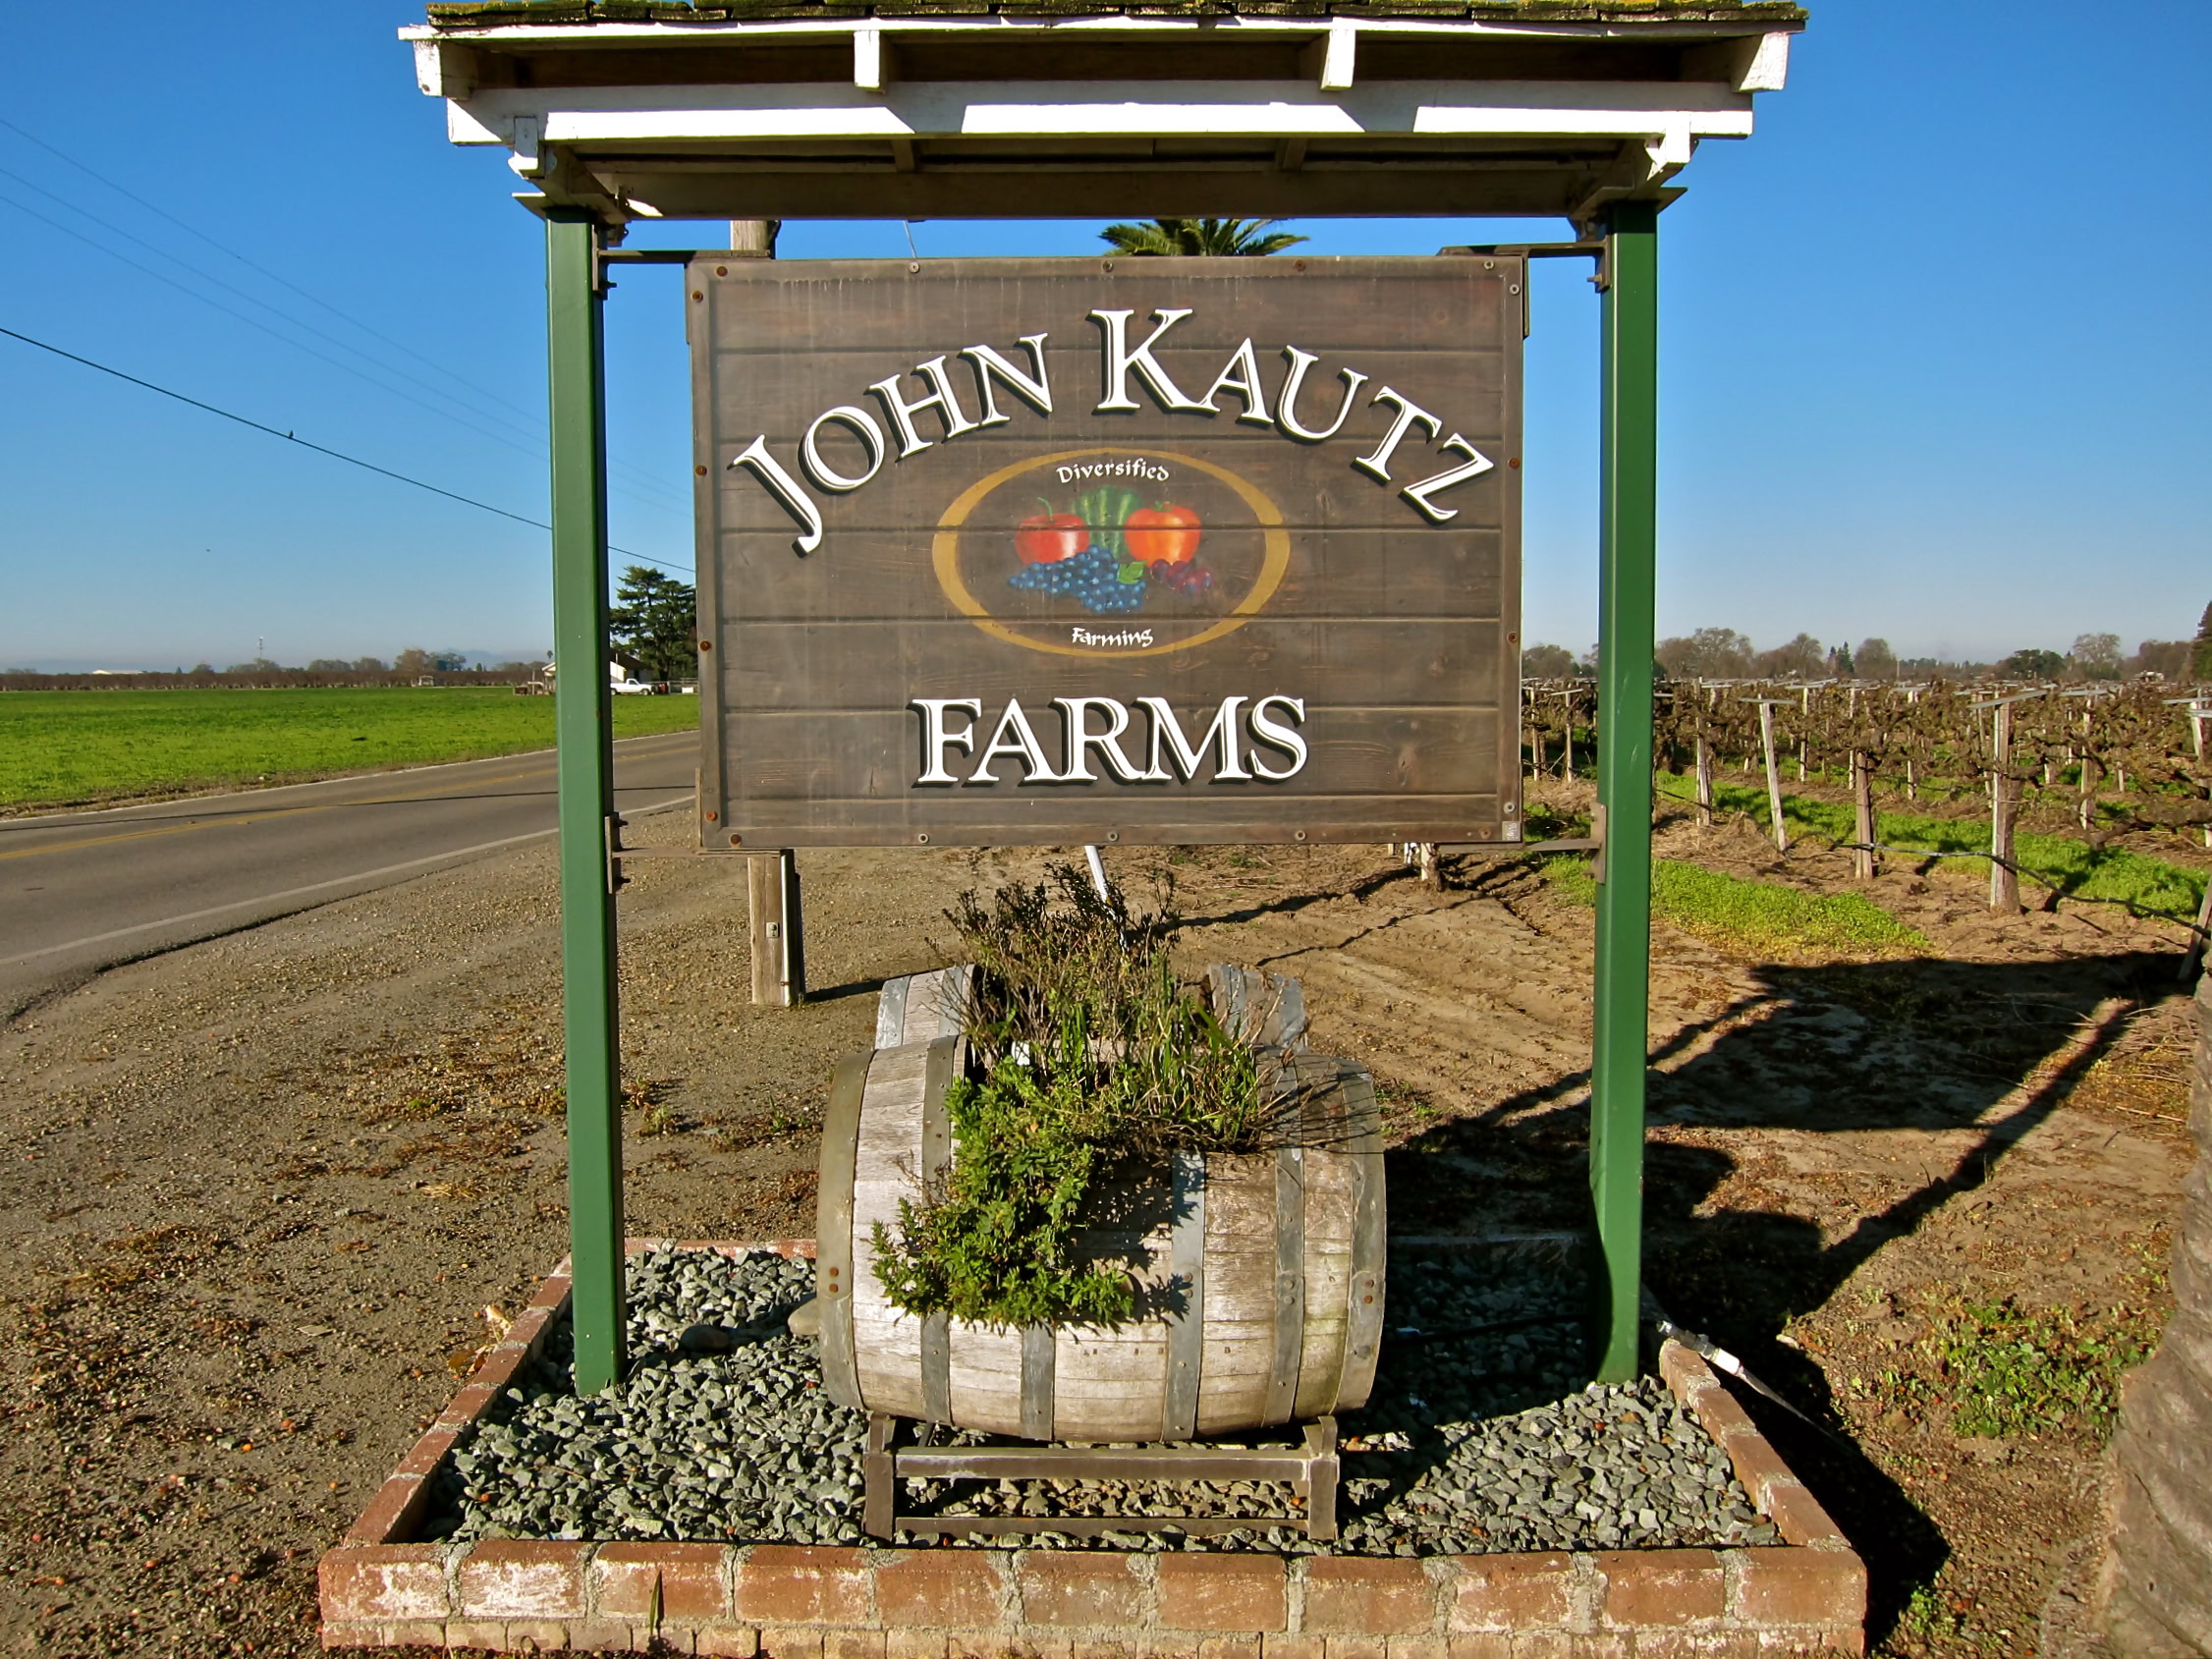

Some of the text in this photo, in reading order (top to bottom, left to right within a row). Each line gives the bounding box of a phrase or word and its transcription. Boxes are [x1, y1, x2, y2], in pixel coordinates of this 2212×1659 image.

[730, 307, 1495, 553] JOHN KAUTZ
[1055, 457, 1170, 483] Diversified
[1072, 627, 1154, 647] Farming
[910, 694, 1308, 783] FARMS
